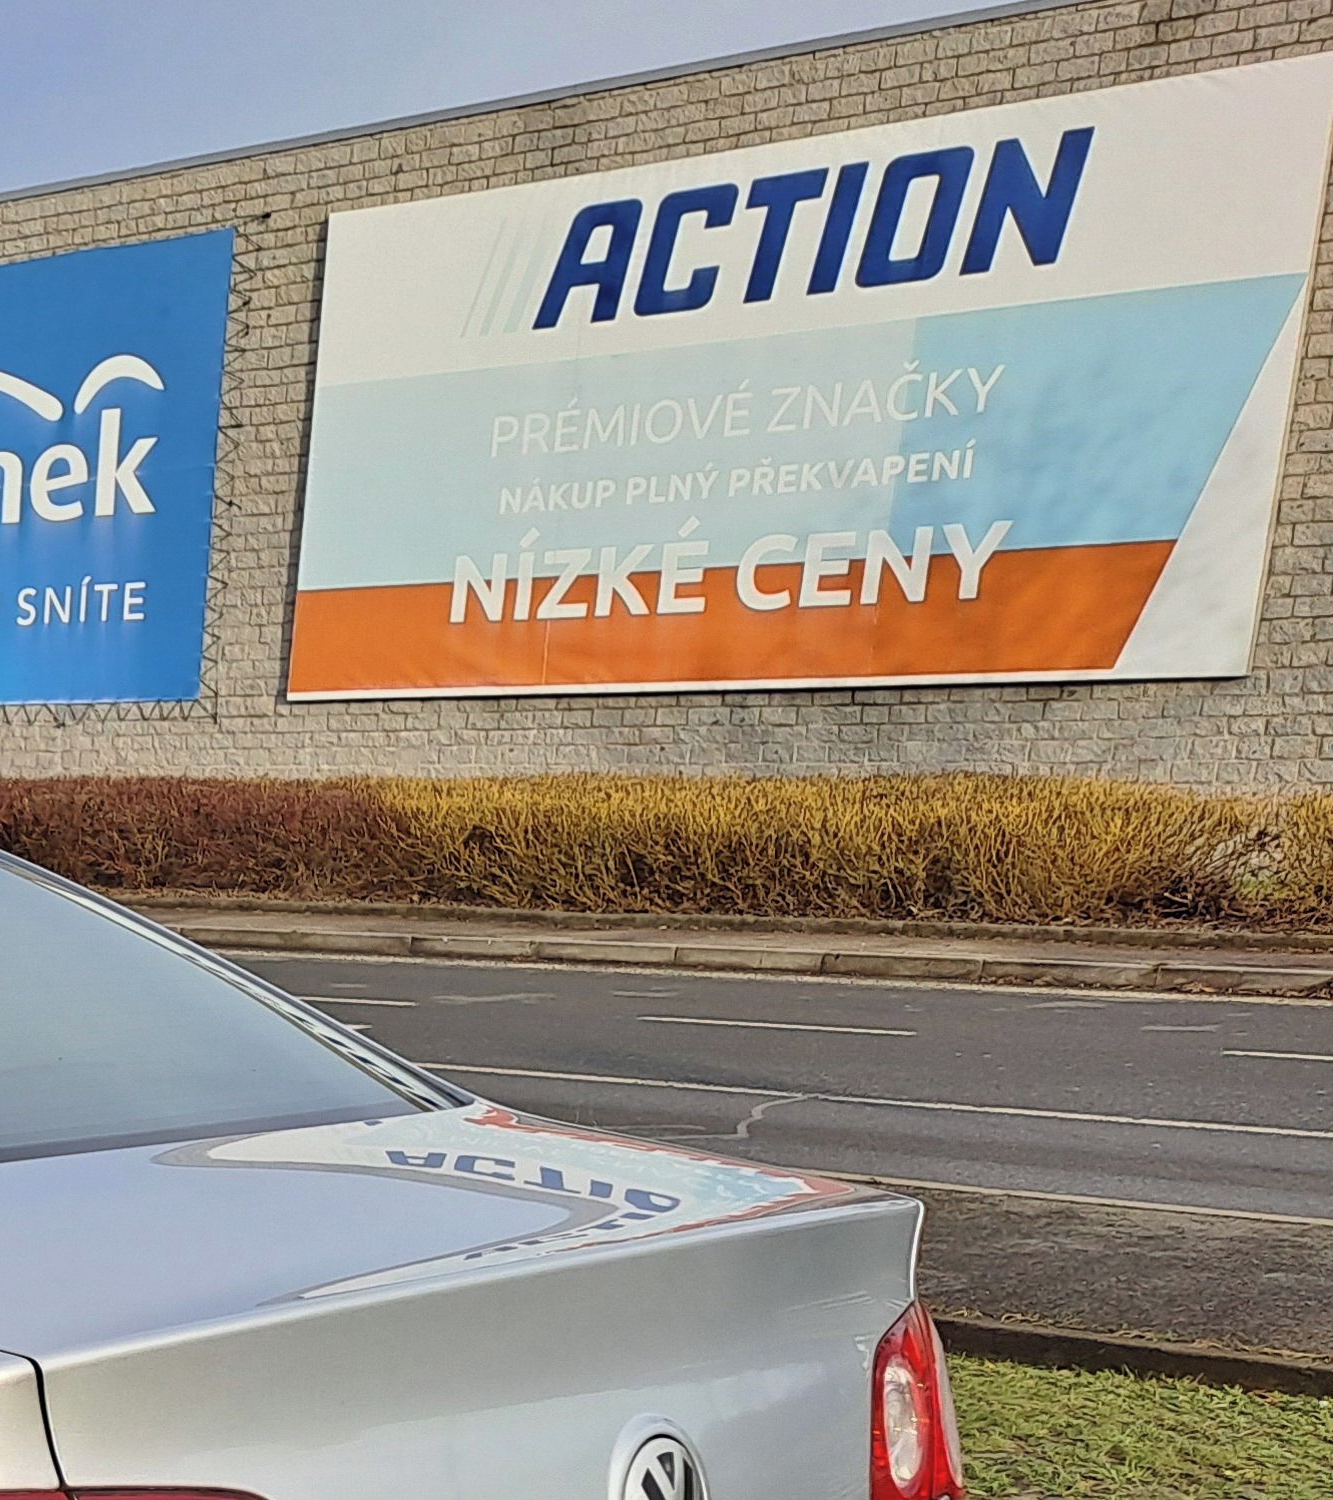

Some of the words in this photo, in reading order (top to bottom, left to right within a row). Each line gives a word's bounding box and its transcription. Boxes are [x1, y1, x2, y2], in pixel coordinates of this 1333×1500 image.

[533, 127, 1095, 330] ACTION
[490, 376, 752, 459] PRÉMIOVÉ
[769, 359, 1006, 430] ZNAČKY
[498, 479, 616, 516] NÁKUP
[625, 462, 718, 505] PLNÝ
[728, 439, 978, 498] PŘEKVAPENÍ
[16, 576, 146, 627] SNÍTE
[449, 516, 710, 624] NÍZKÉ
[736, 520, 1014, 611] CENY
